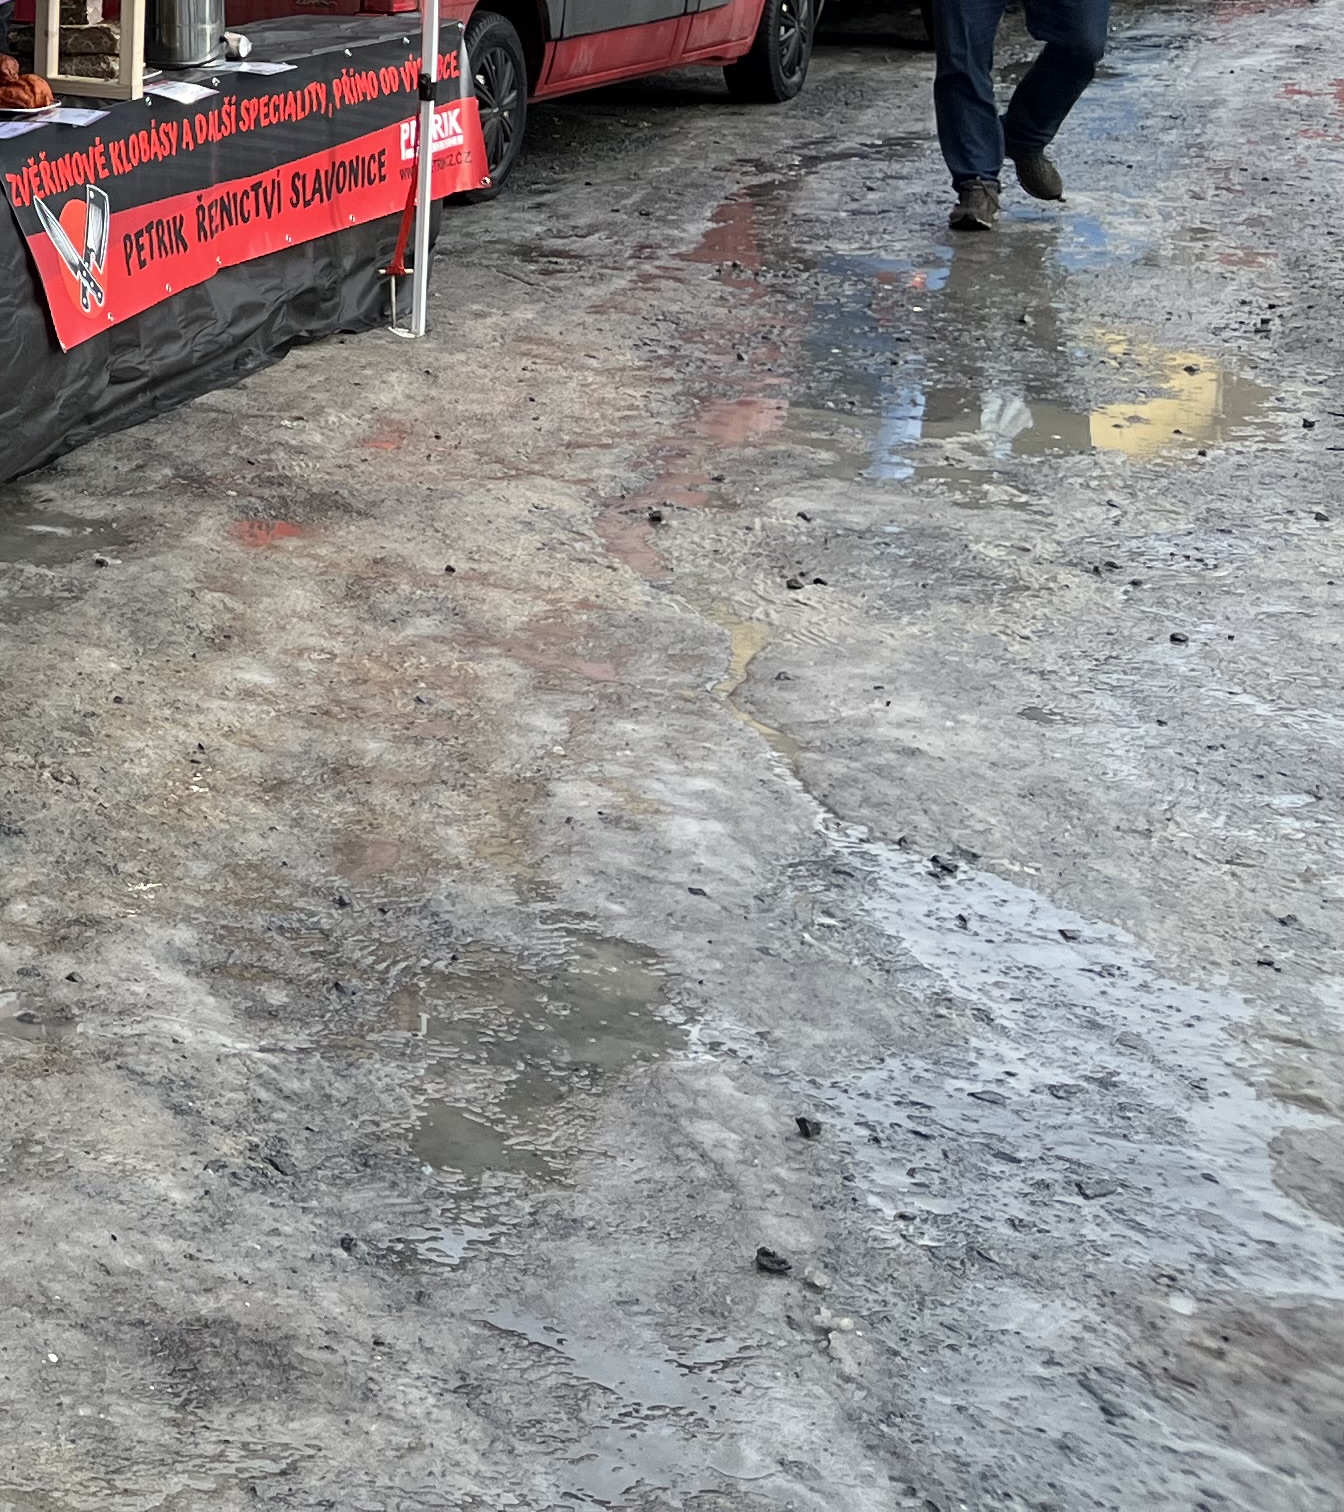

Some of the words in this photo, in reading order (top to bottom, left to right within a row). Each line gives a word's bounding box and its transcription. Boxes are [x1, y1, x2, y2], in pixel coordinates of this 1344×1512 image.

[5, 136, 110, 207] ZVĚŘINOVÉ
[109, 119, 179, 176] KLOBÁSY
[181, 118, 195, 151] A
[332, 67, 379, 110] PŘÍMO
[380, 66, 400, 96] OD
[123, 213, 189, 276] PETRIK
[290, 148, 387, 208] SLAVONICE
